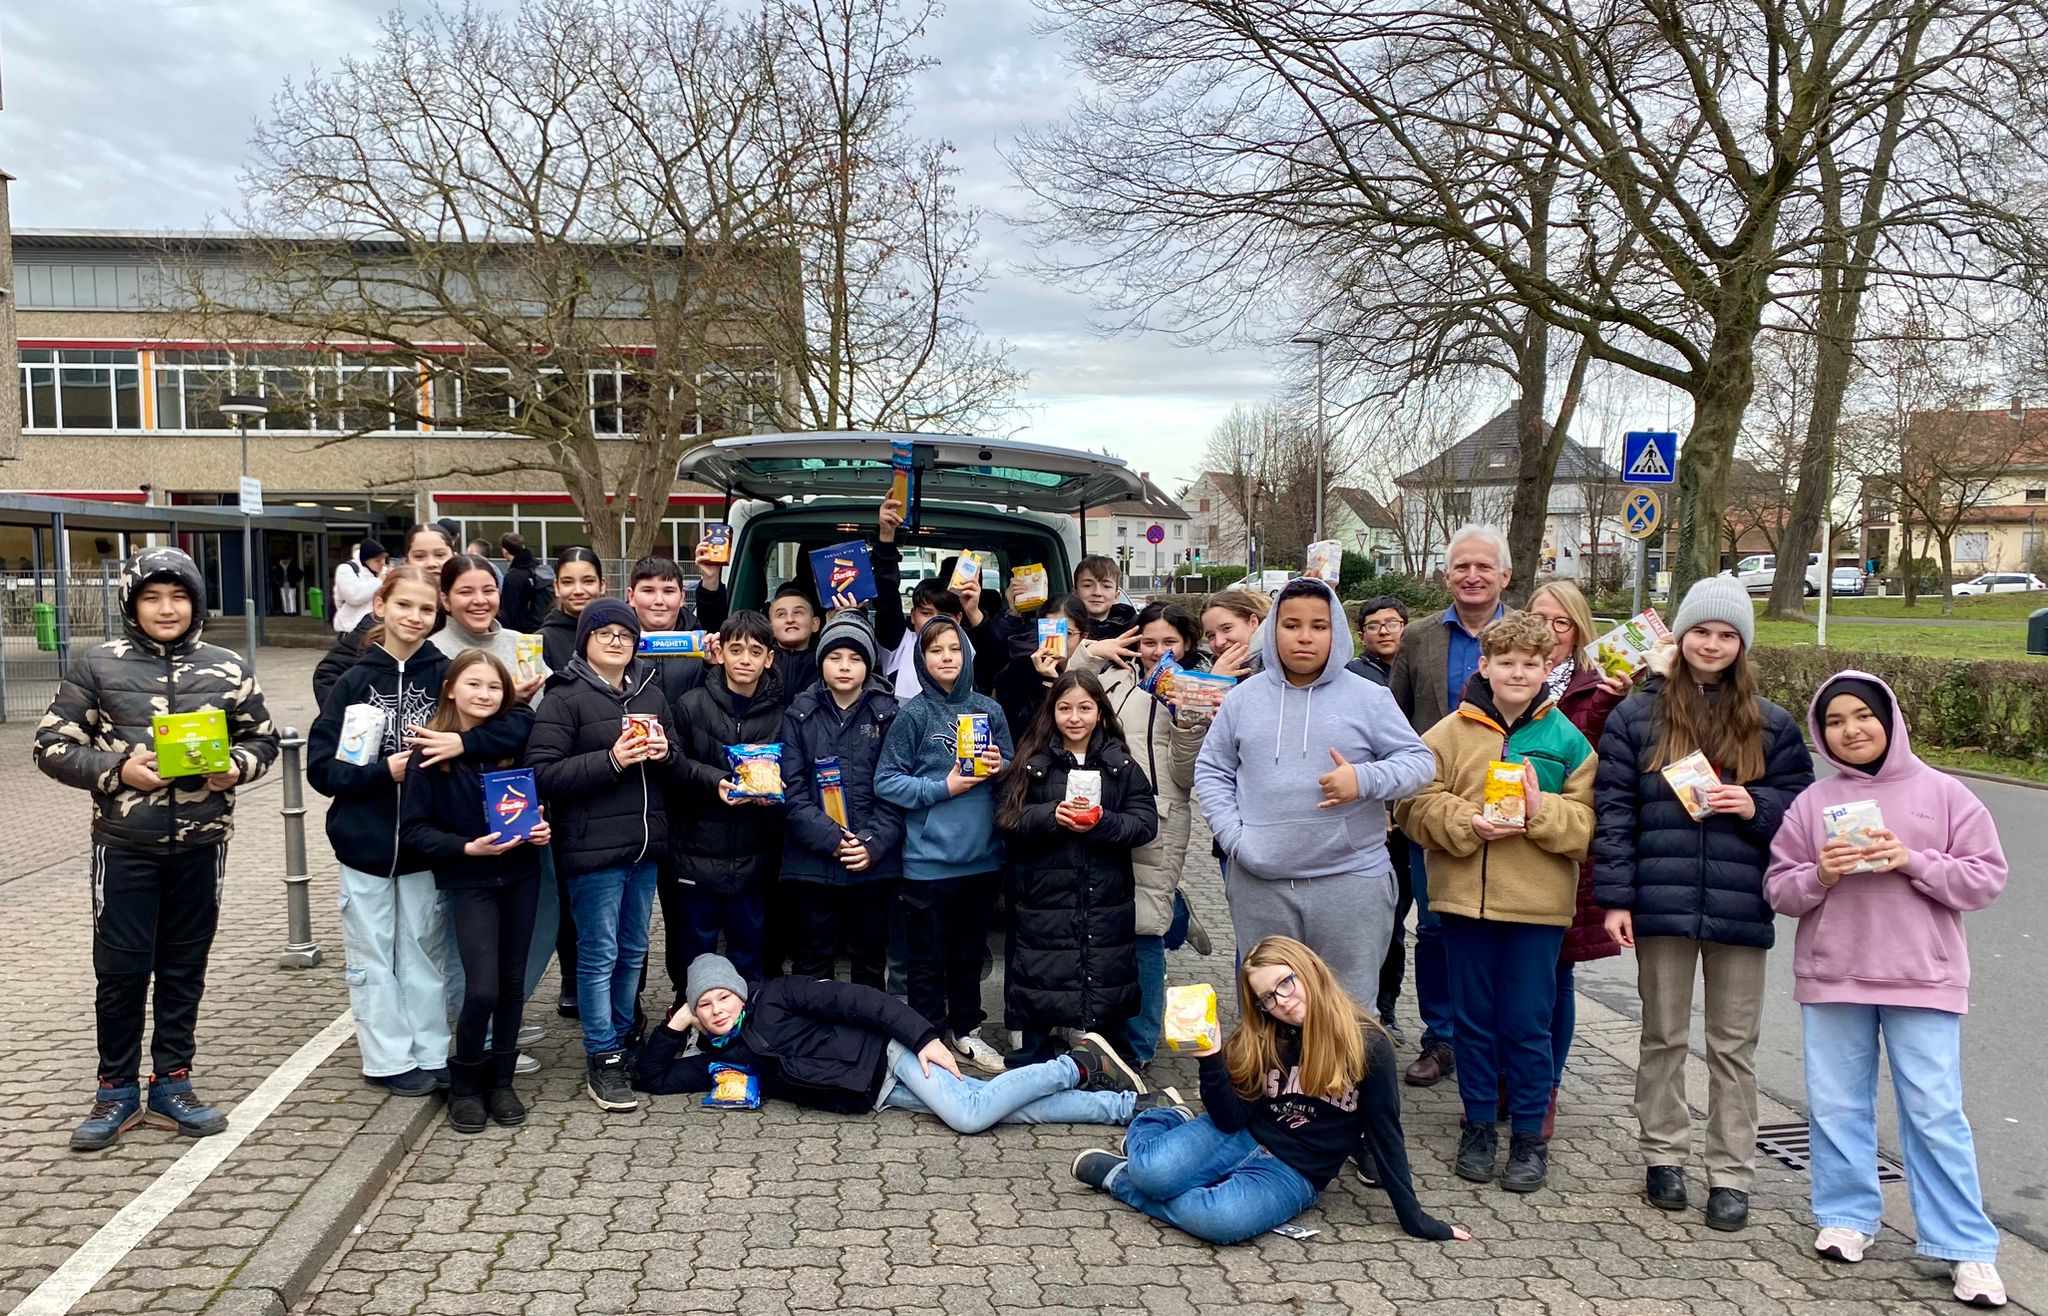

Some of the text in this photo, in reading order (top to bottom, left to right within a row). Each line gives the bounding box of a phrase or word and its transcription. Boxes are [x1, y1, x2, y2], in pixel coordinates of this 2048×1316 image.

[833, 569, 857, 582] Barilla
[1645, 610, 1667, 638] LEIME
[652, 639, 689, 648] SPAGHETTI
[1624, 633, 1645, 652] CROUT
[500, 801, 526, 811] Barilla
[1830, 807, 1848, 822] ja!
